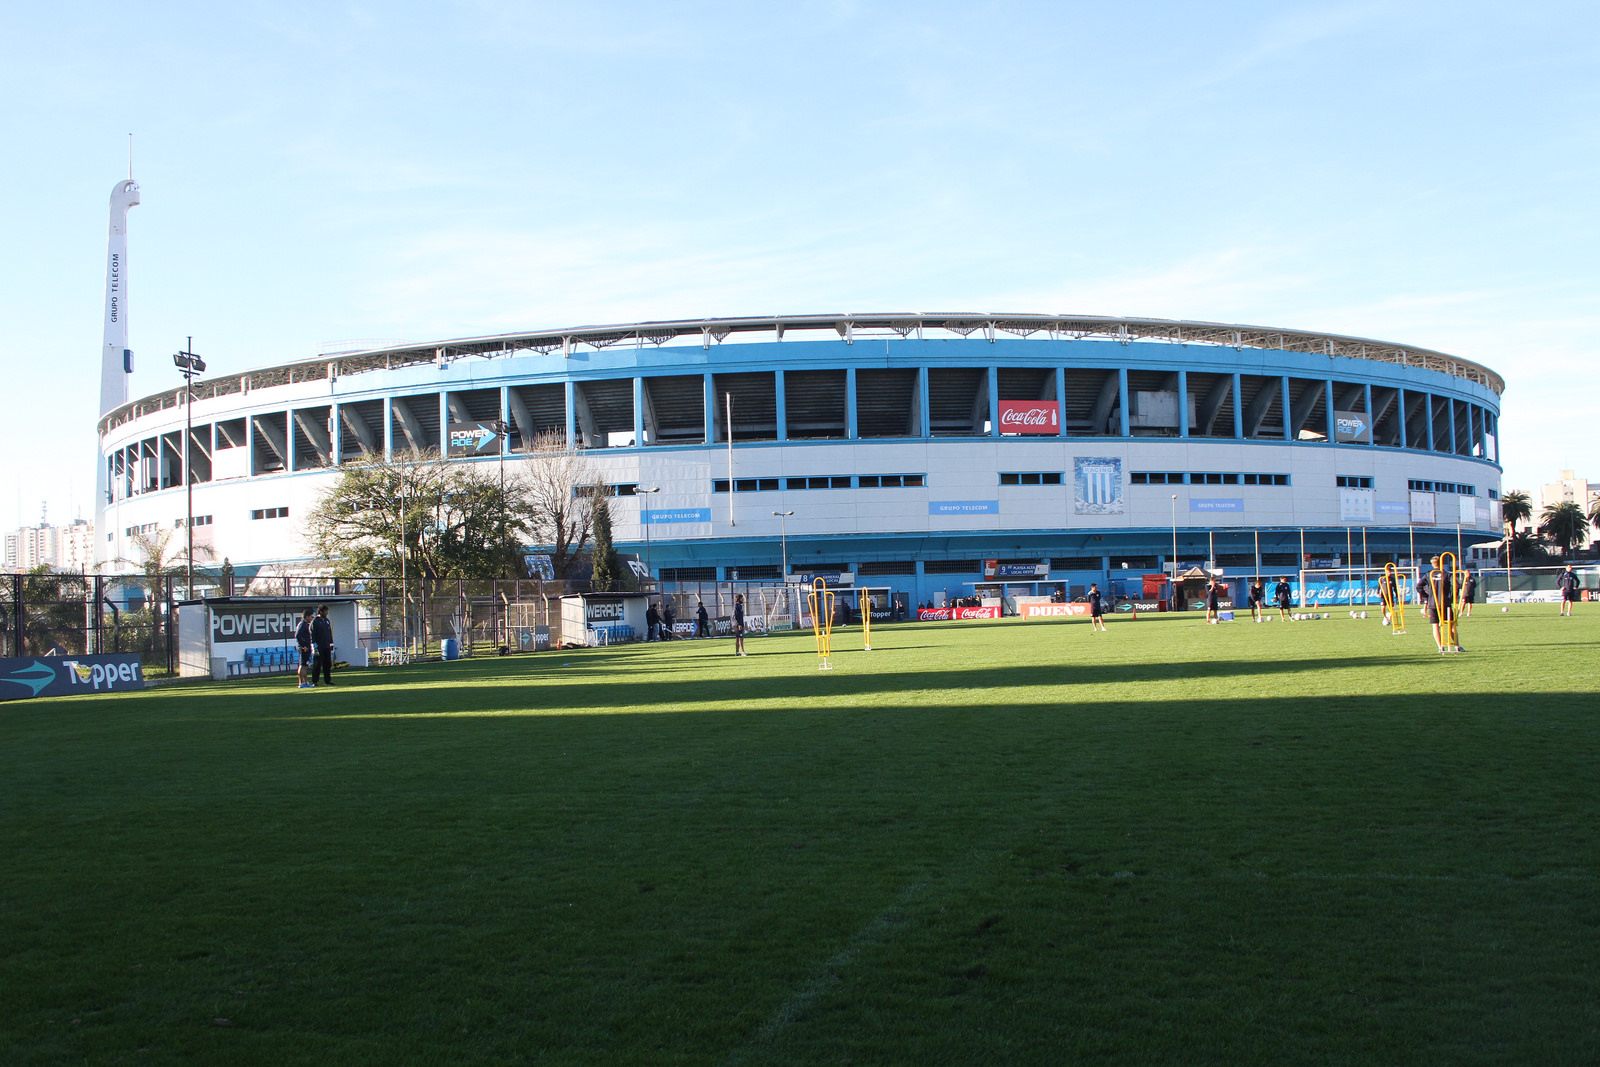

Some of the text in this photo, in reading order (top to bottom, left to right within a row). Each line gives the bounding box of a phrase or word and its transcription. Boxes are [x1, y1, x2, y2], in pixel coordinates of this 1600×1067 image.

[110, 253, 120, 323] GRUPO TELECOM
[1001, 408, 1049, 425] Coca-Cola
[450, 429, 489, 440] POWER
[586, 603, 623, 618] WERADE
[869, 610, 892, 619] Topper
[1134, 602, 1158, 612] Topper
[213, 613, 304, 635] POWERAD
